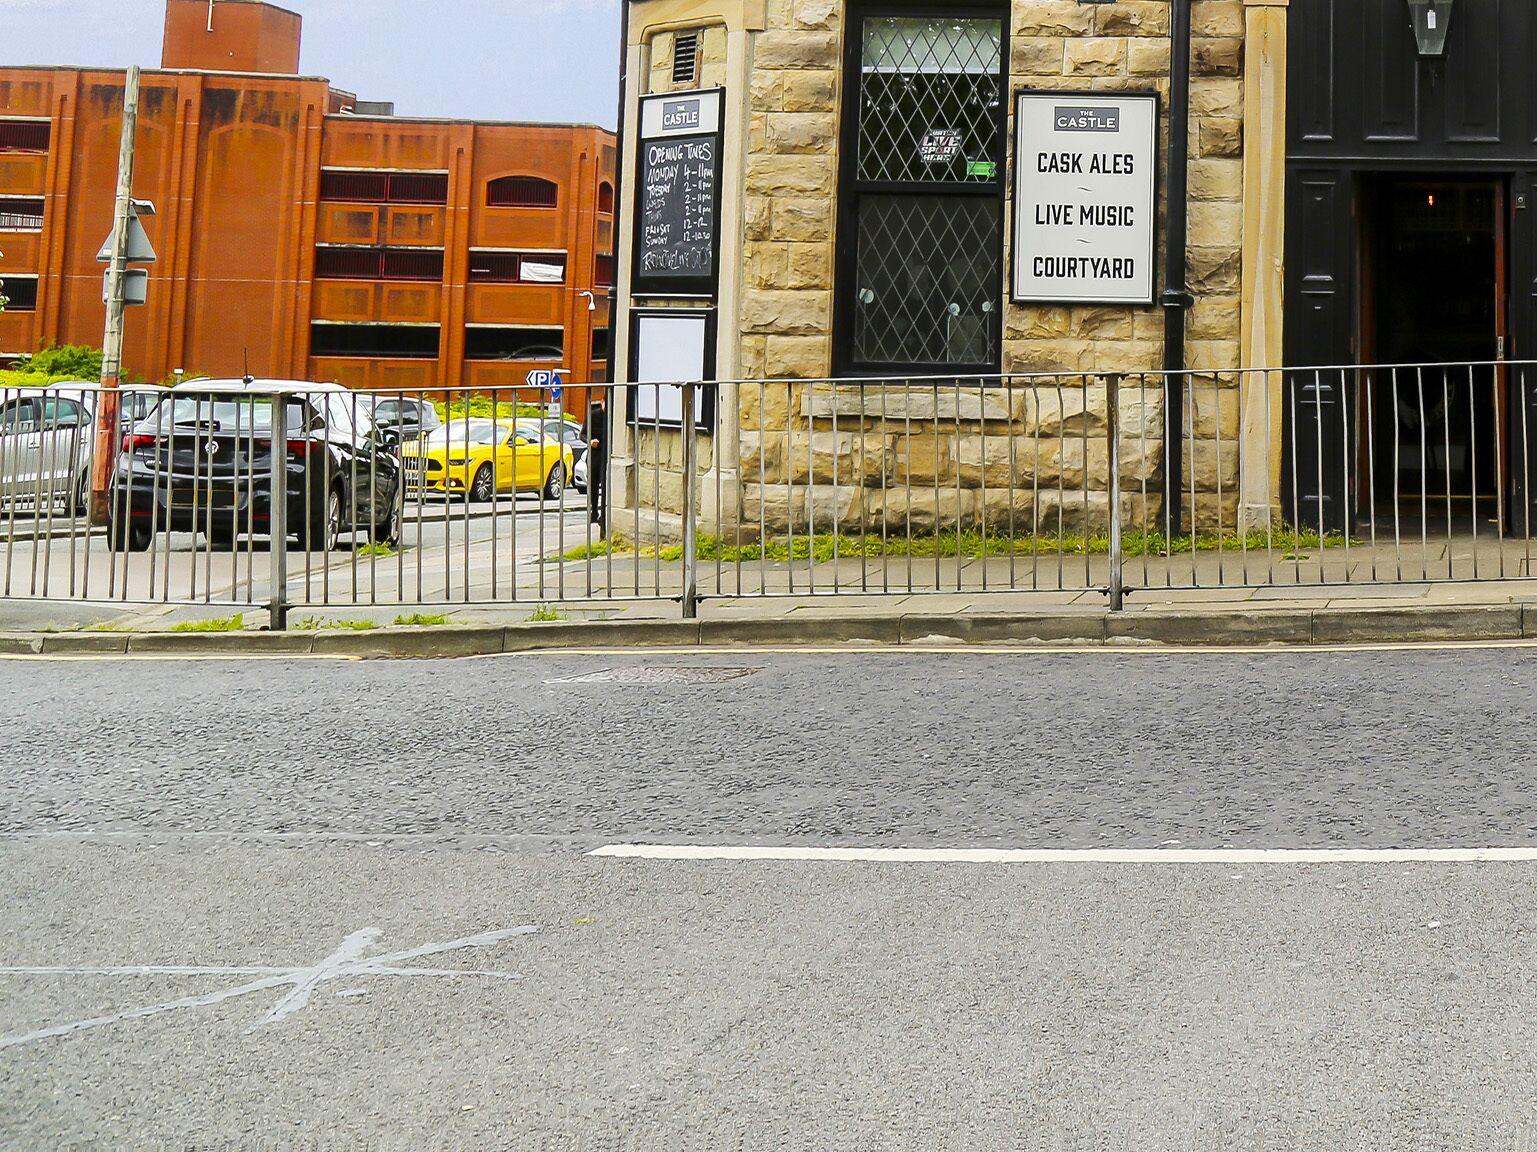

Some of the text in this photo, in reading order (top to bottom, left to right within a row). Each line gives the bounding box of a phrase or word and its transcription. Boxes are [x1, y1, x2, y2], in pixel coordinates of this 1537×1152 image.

[664, 111, 698, 126] CASTLE
[1057, 117, 1116, 129] CASTLE
[922, 136, 961, 146] LIVE
[649, 145, 683, 166] OPENING
[1037, 152, 1134, 175] CASK ALES
[648, 164, 679, 185] MONDAY
[1035, 204, 1134, 227] LIVE MUSIC
[1033, 256, 1134, 279] COURTYARD
[537, 373, 547, 386] P
